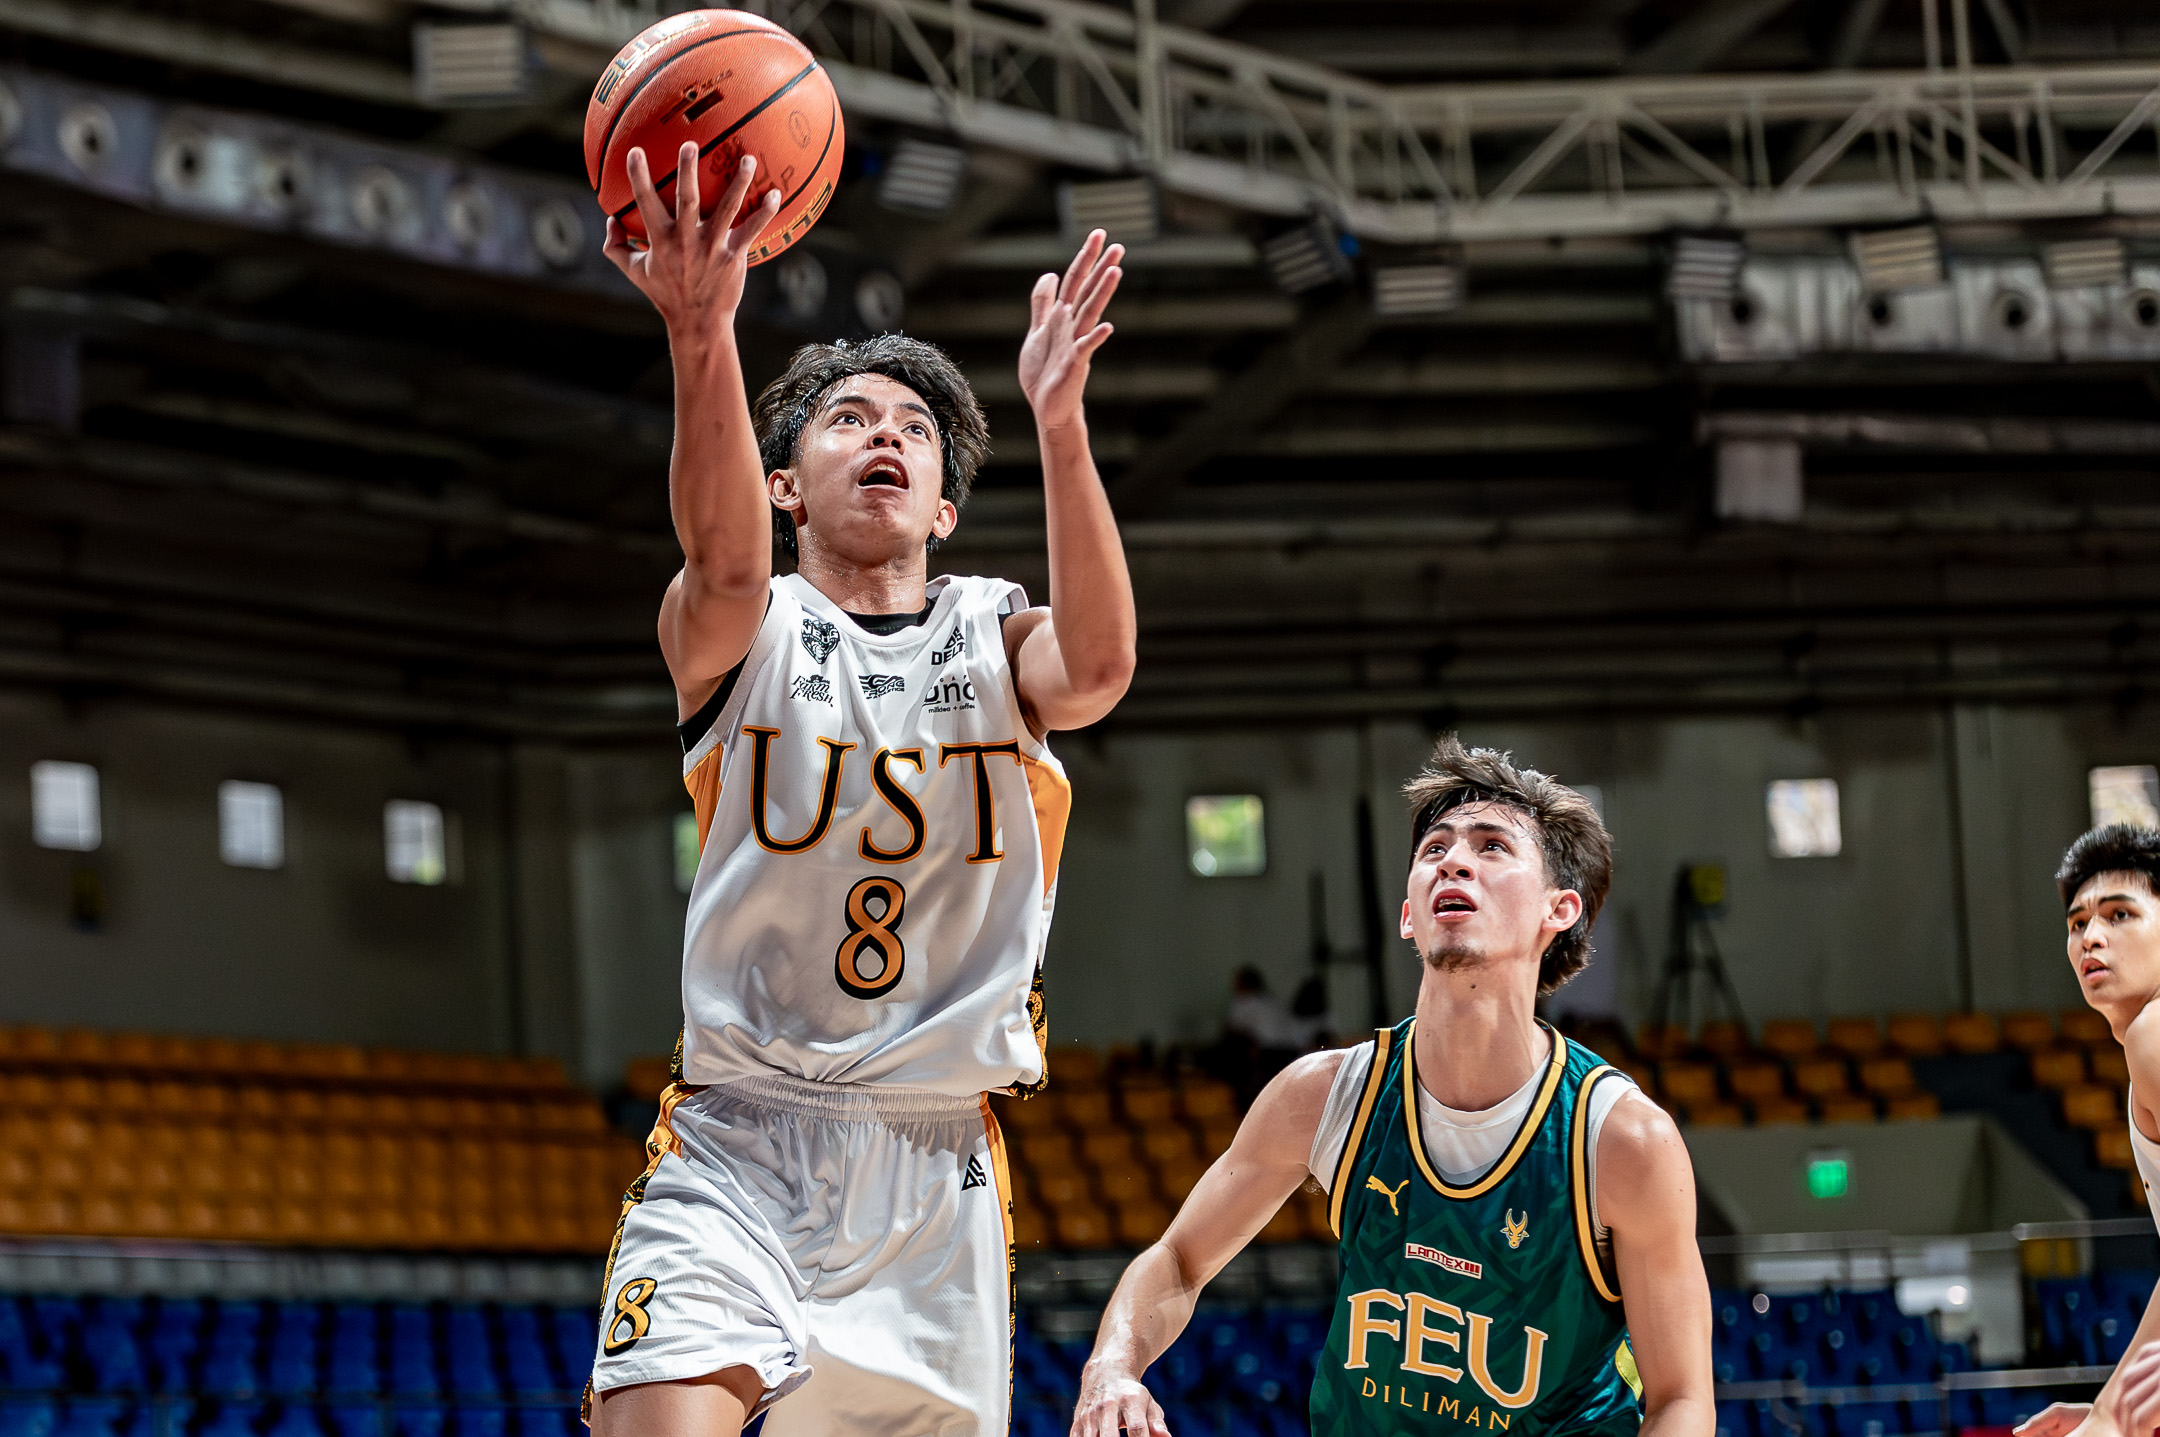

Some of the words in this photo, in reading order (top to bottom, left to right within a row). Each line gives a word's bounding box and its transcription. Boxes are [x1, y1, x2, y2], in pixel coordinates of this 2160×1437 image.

[931, 641, 967, 665] DELT
[741, 725, 1023, 864] UST
[835, 875, 906, 1000] 8
[604, 1277, 657, 1357] 8
[1344, 1288, 1548, 1409] FEU
[1361, 1377, 1512, 1431] DILIMAN
